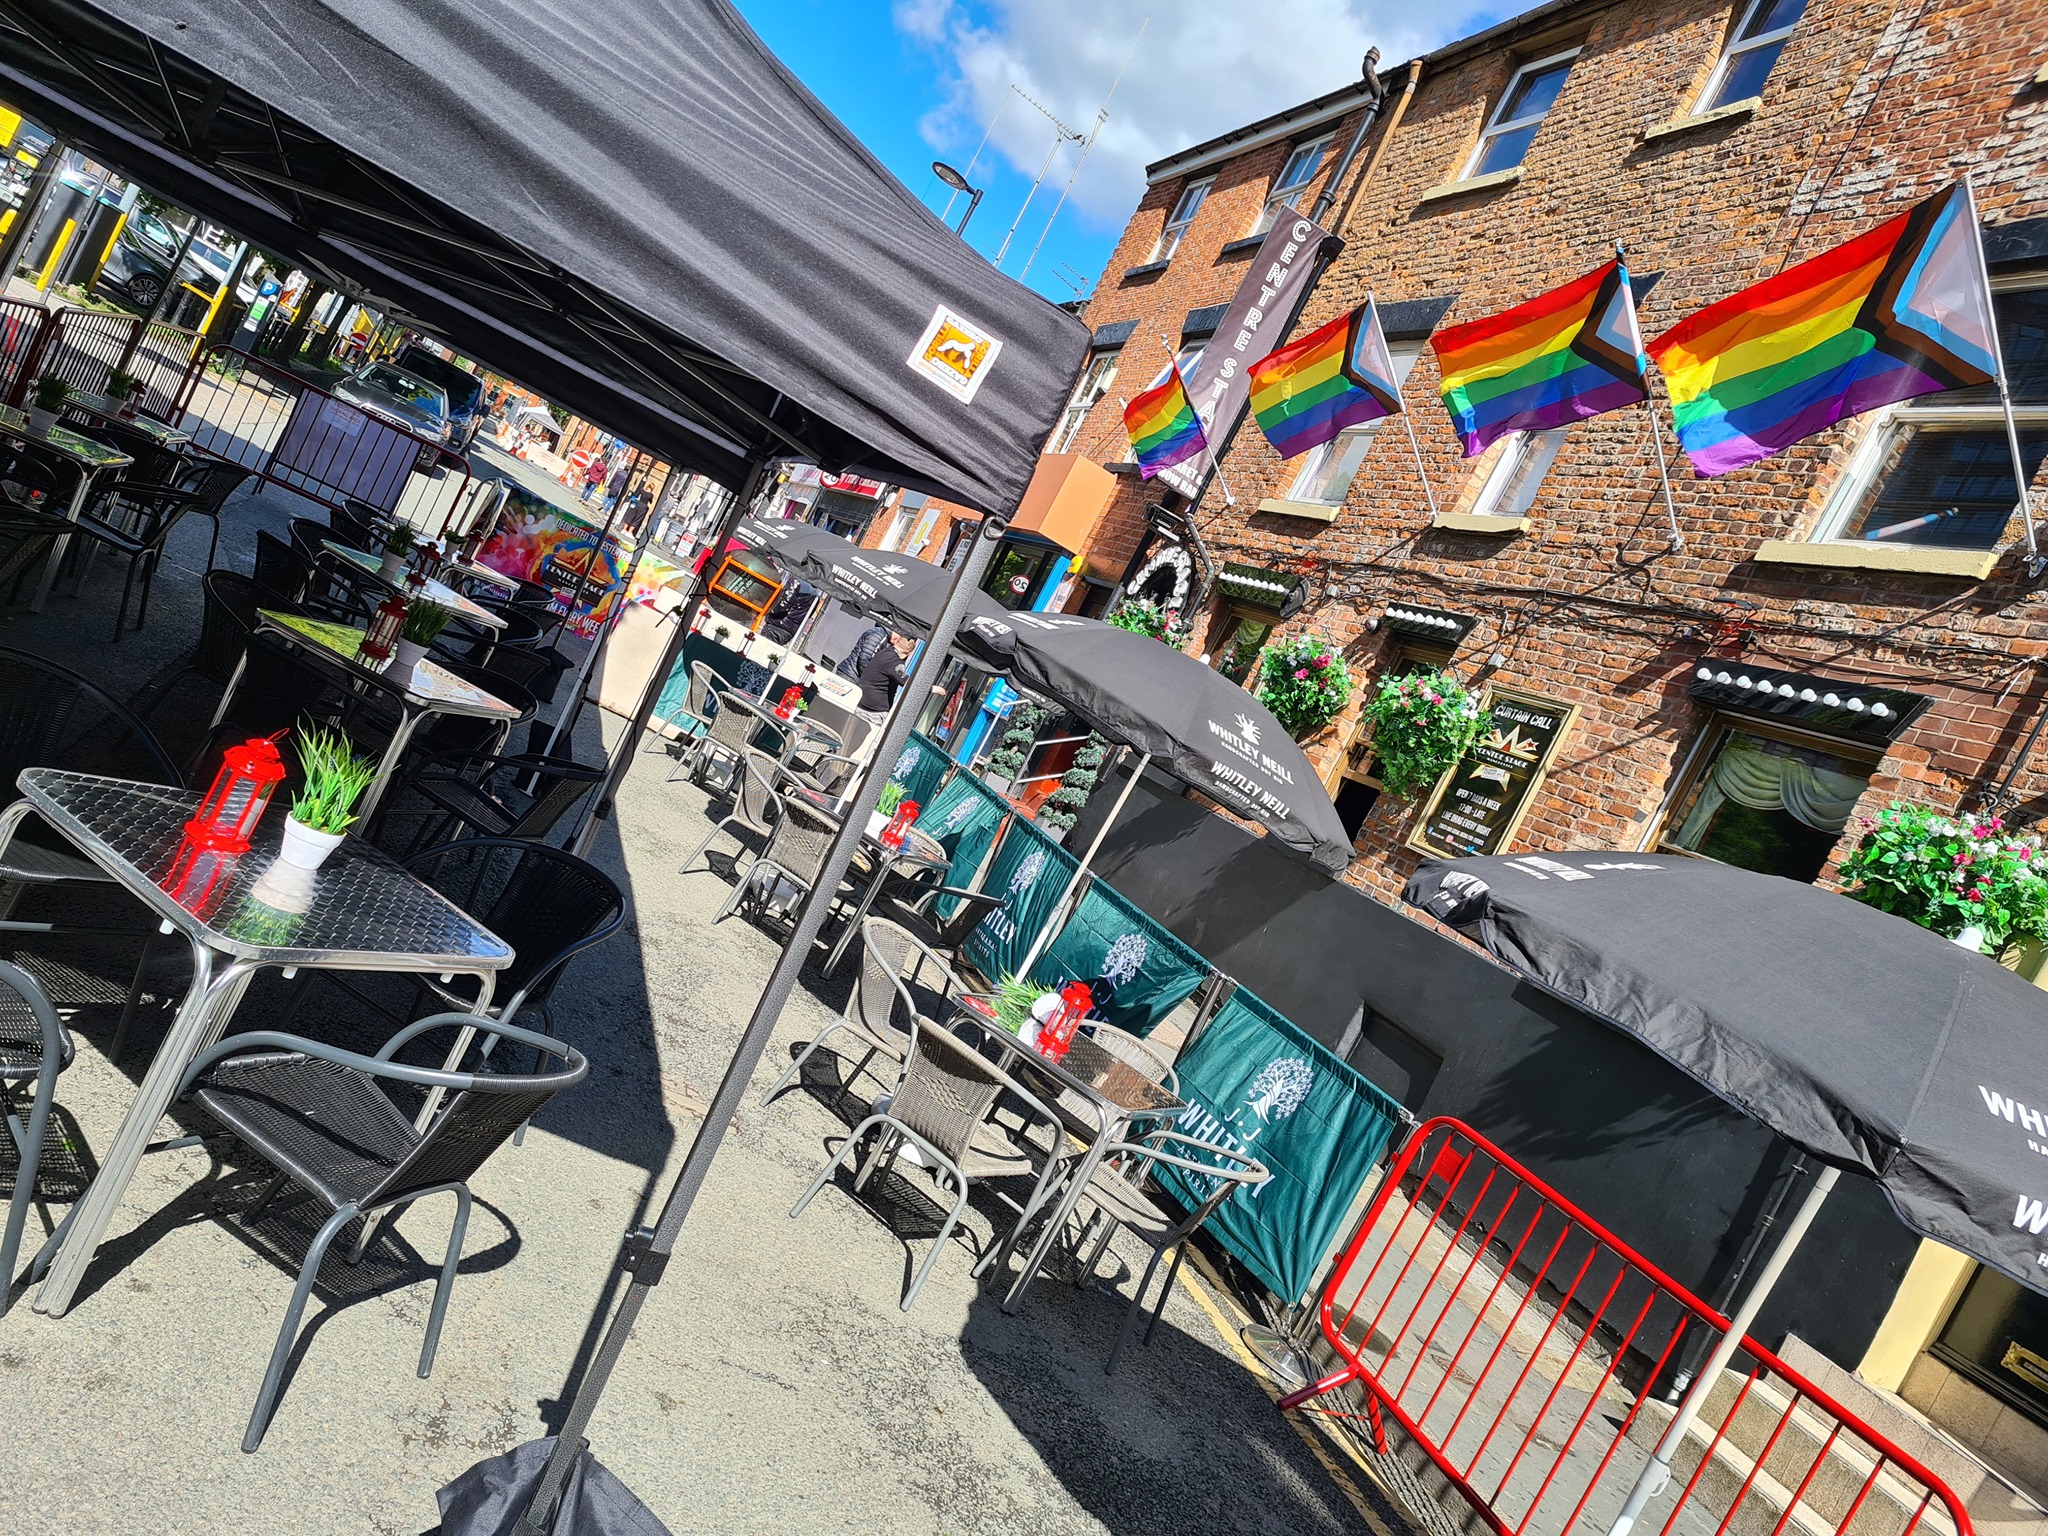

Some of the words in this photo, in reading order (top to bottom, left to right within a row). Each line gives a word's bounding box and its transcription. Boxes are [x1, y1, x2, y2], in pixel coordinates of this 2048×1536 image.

[263, 281, 274, 293] P
[1233, 220, 1312, 352] CENTRE
[923, 322, 951, 362] GORILLA
[964, 340, 991, 379] GORILLA
[556, 519, 588, 541] DEDICATED
[588, 534, 598, 545] TO
[545, 563, 578, 584] CENTRE
[583, 580, 605, 596] TAGE
[831, 563, 862, 586] WHITLEY
[859, 581, 878, 599] NEILL
[558, 604, 583, 625] EVRY
[582, 615, 601, 634] WEE
[1495, 705, 1531, 724] CURTAIN
[1529, 715, 1553, 730] CALL
[1208, 719, 1260, 760] WHITLEY
[1261, 753, 1295, 786] NEILL
[1221, 741, 1260, 769] HANDCRAFTED
[1260, 766, 1272, 777] DRY
[1477, 747, 1504, 760] CENTRE
[1504, 755, 1529, 768] STAGE
[1210, 760, 1263, 797] WHITLEY
[1258, 790, 1291, 820] NEILL
[1214, 780, 1251, 805] HANDCRAFTED
[1250, 802, 1262, 812] DRY
[1259, 807, 1271, 818] GIN
[1456, 787, 1470, 799] OPEN
[1467, 791, 1473, 800] 7
[1470, 793, 1485, 805] DAYS
[1482, 797, 1488, 806] A
[1486, 799, 1502, 812] WEEK
[1441, 810, 1453, 821] LIVE
[1450, 813, 1464, 826] DRAG
[1461, 818, 1478, 831] EVERY
[1475, 823, 1492, 837] NIGHT
[1472, 809, 1487, 820] LATE
